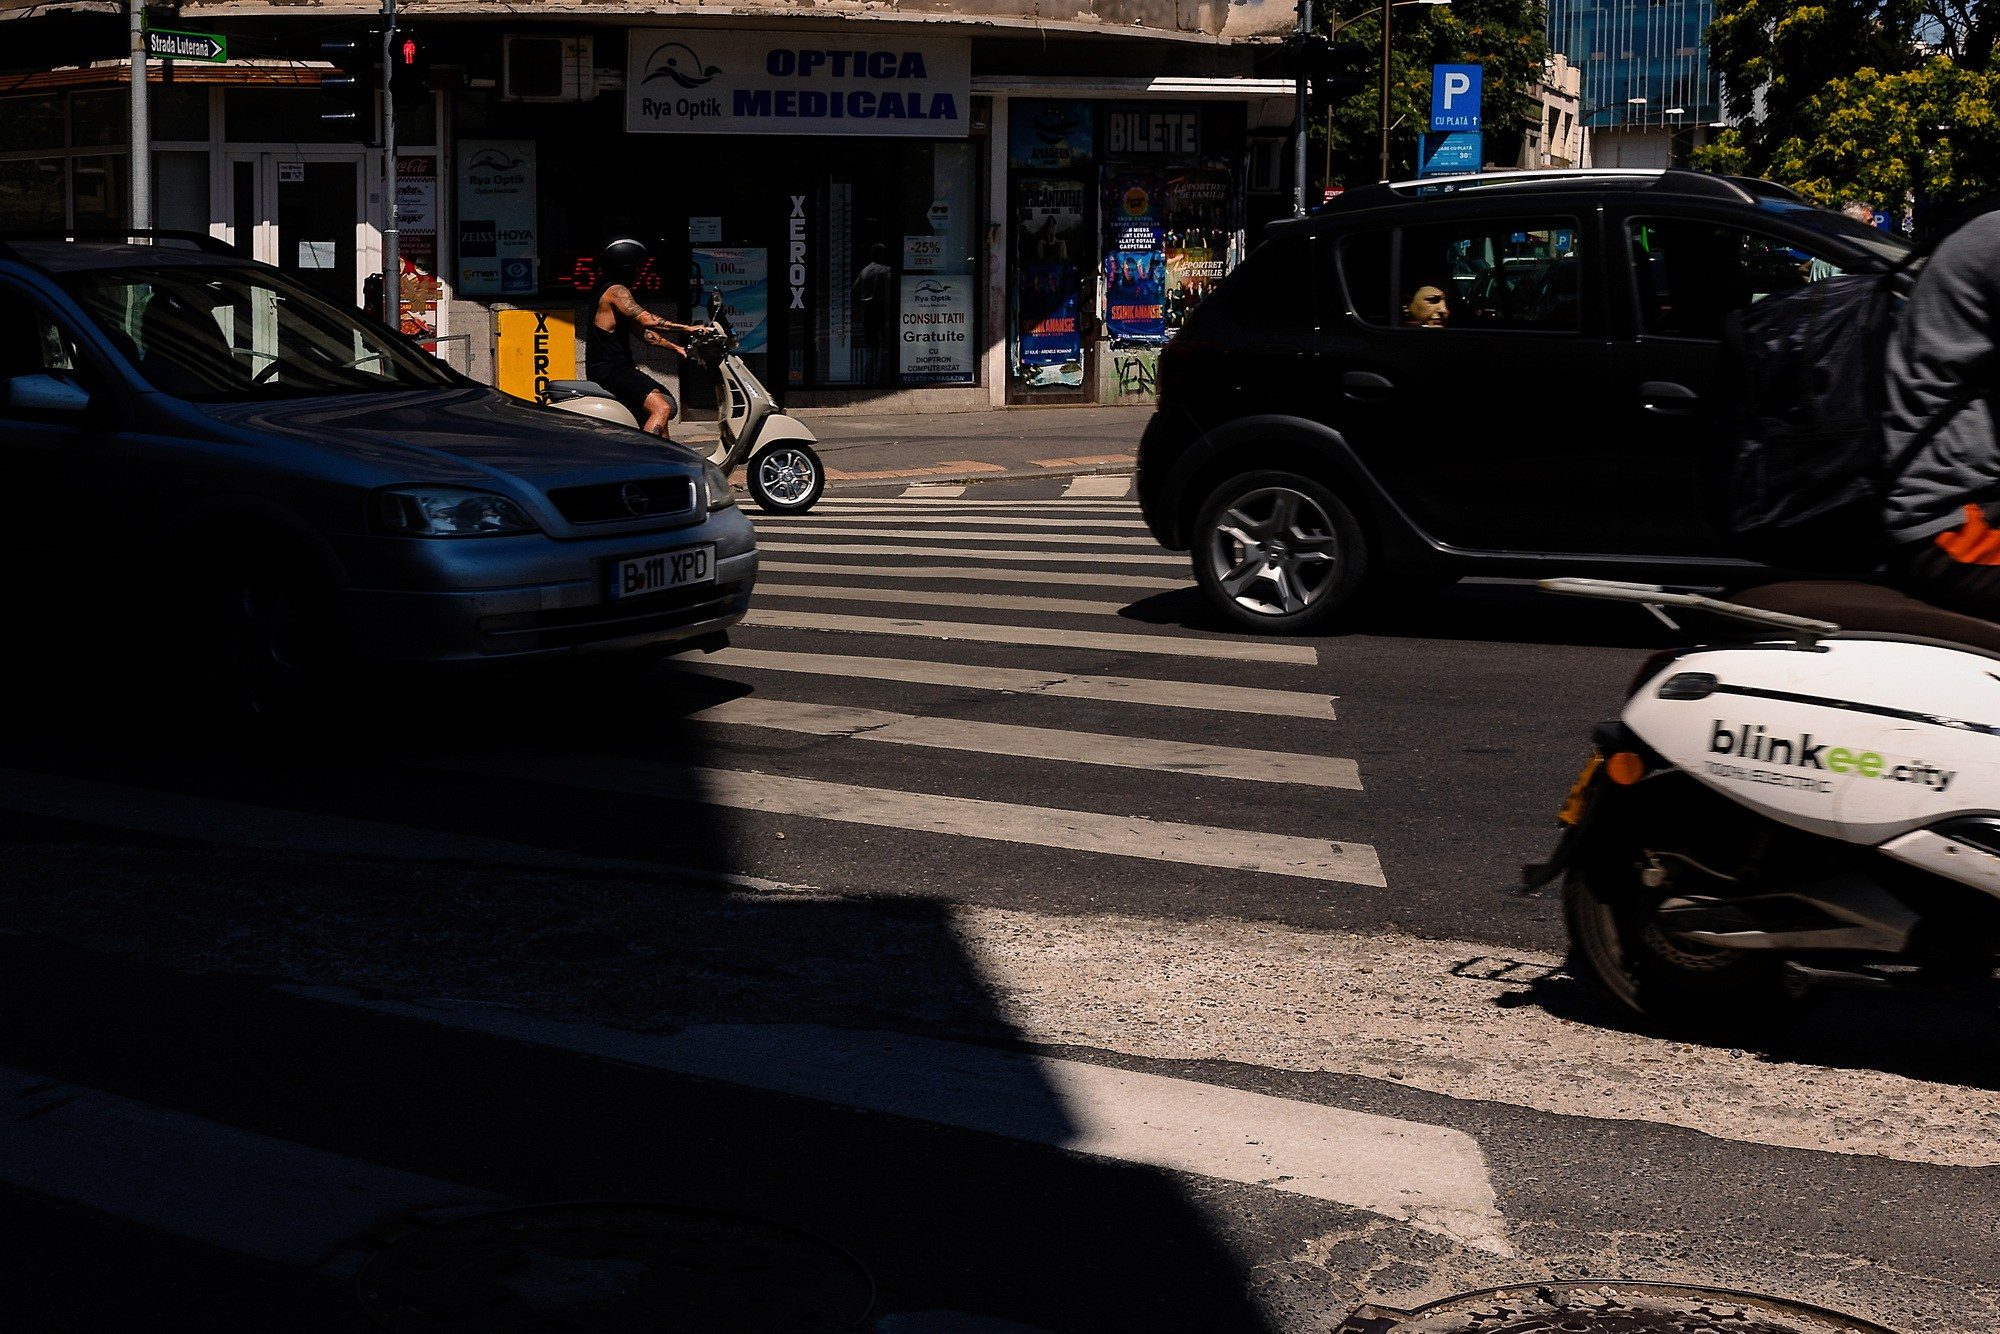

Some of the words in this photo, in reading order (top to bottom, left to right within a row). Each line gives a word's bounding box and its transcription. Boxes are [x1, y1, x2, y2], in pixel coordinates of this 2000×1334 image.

[150, 33, 176, 53] Strada
[176, 36, 209, 57] Luterană
[766, 48, 927, 79] OPTICA
[1444, 72, 1470, 110] P
[642, 98, 671, 120] Rya
[676, 98, 722, 120] Optik
[733, 89, 958, 120] MEDICALA
[1435, 116, 1445, 126] CU
[1109, 112, 1196, 153] BILETE
[470, 175, 491, 188] Rya
[493, 174, 525, 187] Optik
[1188, 182, 1228, 191] PORTRET
[1192, 191, 1227, 199] FAMILIE
[460, 231, 495, 243] ZEISS
[497, 229, 534, 241] HOYA
[788, 195, 806, 309] XEROX
[910, 241, 941, 254] -25%
[1187, 261, 1224, 269] PORTRET
[471, 269, 499, 278] rhein
[1180, 269, 1191, 277] DE
[1191, 269, 1224, 277] FAMILIE
[915, 295, 929, 303] Rya
[930, 295, 952, 303] Optik
[903, 313, 965, 325] CONSULTATII
[1045, 317, 1075, 333] ANANSIE
[903, 330, 966, 343] Gratuite
[916, 356, 952, 364] DIOPTRON
[907, 364, 960, 372] COMPUTERIZAT
[624, 563, 639, 593] B
[644, 557, 665, 589] 111
[670, 549, 707, 584] XPD
[1709, 719, 1958, 793] blinkee.city
